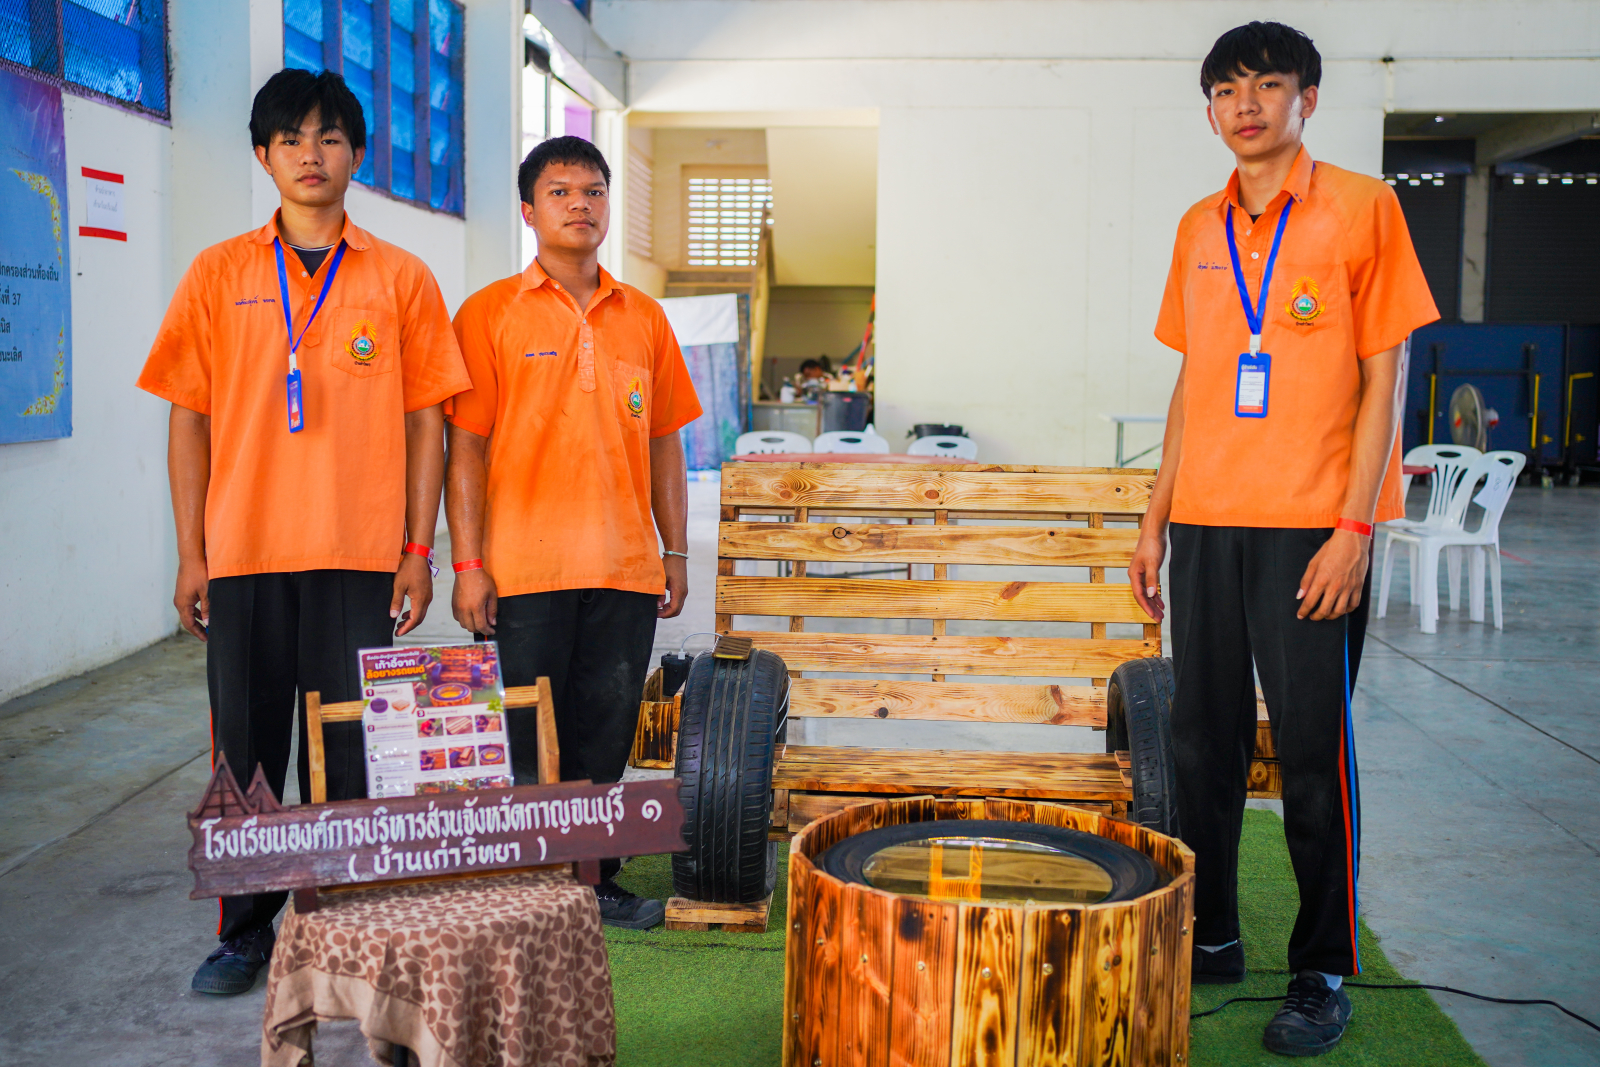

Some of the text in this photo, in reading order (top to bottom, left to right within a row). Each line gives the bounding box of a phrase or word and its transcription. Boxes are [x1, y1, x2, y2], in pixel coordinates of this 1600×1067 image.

[0, 262, 59, 281] กครองส่วนท้องถิ่น
[12, 293, 21, 306] 37
[0, 317, 10, 333] นิส
[366, 664, 425, 679] ล้อยางรถยนต์
[375, 657, 416, 670] เก้าอี้จาก
[641, 799, 662, 822] ๑
[373, 837, 520, 875] บ้านเก่าวิทยา
